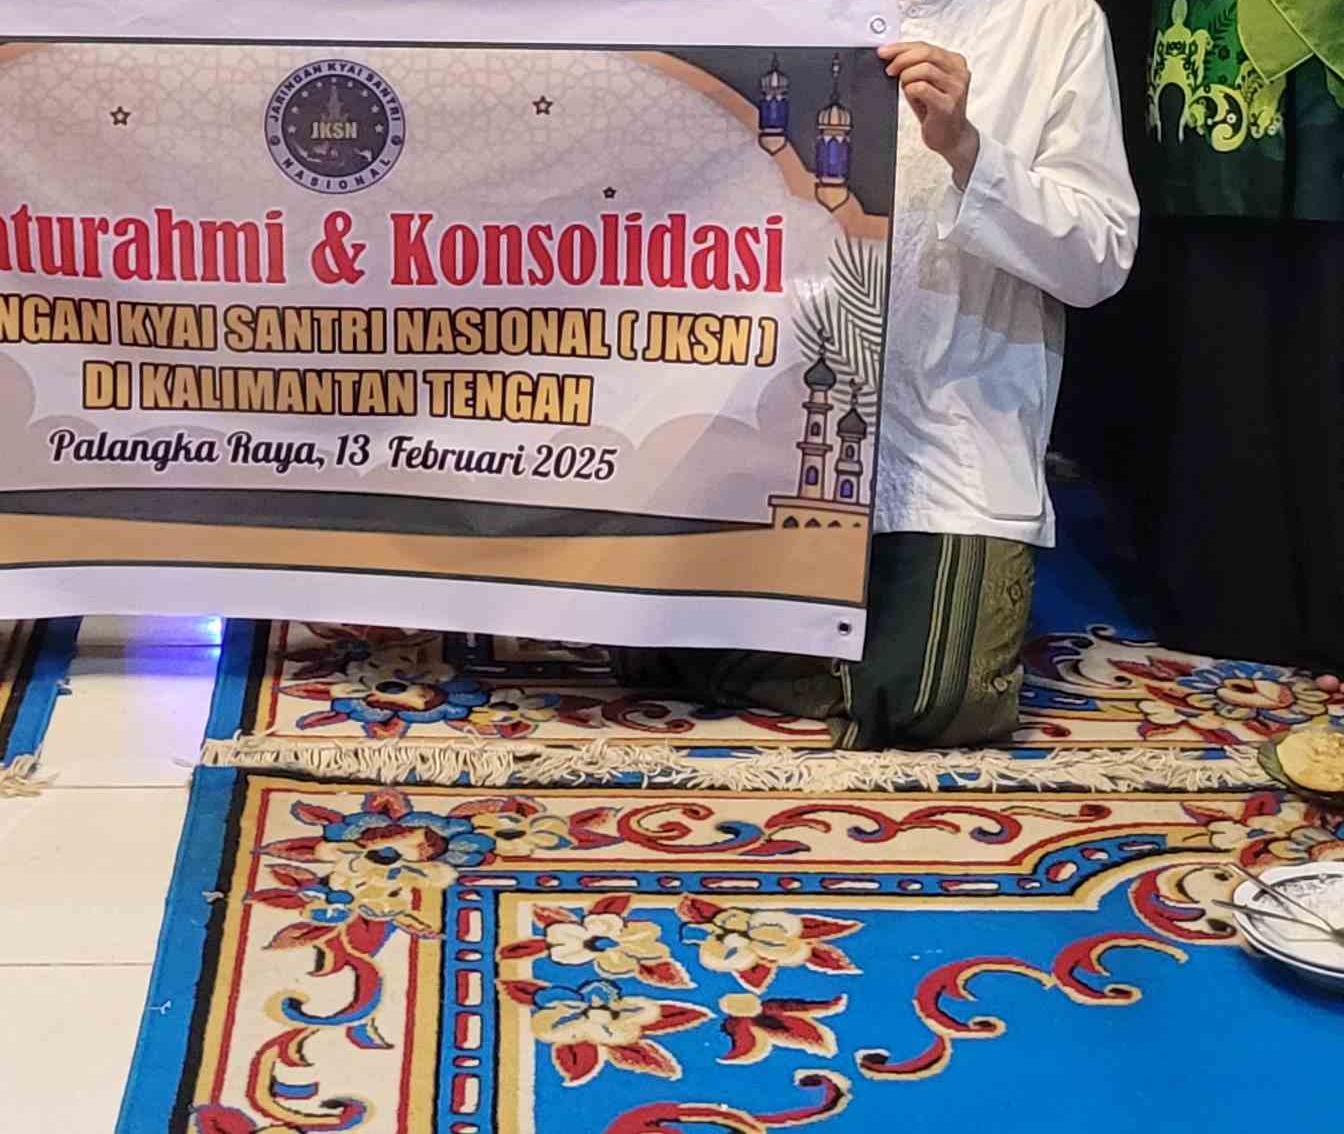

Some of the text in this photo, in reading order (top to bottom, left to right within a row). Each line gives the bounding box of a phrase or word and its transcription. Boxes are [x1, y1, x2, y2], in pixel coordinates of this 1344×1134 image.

[269, 62, 401, 122] JARINGAN KYAI SANTRI
[310, 121, 358, 140] JKSN
[281, 157, 391, 191] NASIONAL
[311, 210, 367, 286] &
[389, 211, 785, 294] Konsolidasi
[119, 301, 217, 351] KYAI
[224, 305, 387, 355] SANTRI
[394, 307, 611, 360] NASIONAL
[642, 312, 753, 366] JKSN
[82, 360, 594, 427] DI KALIMANTAN TENGAH
[49, 429, 617, 481] Palangka Raya, 13 Februari 2025
